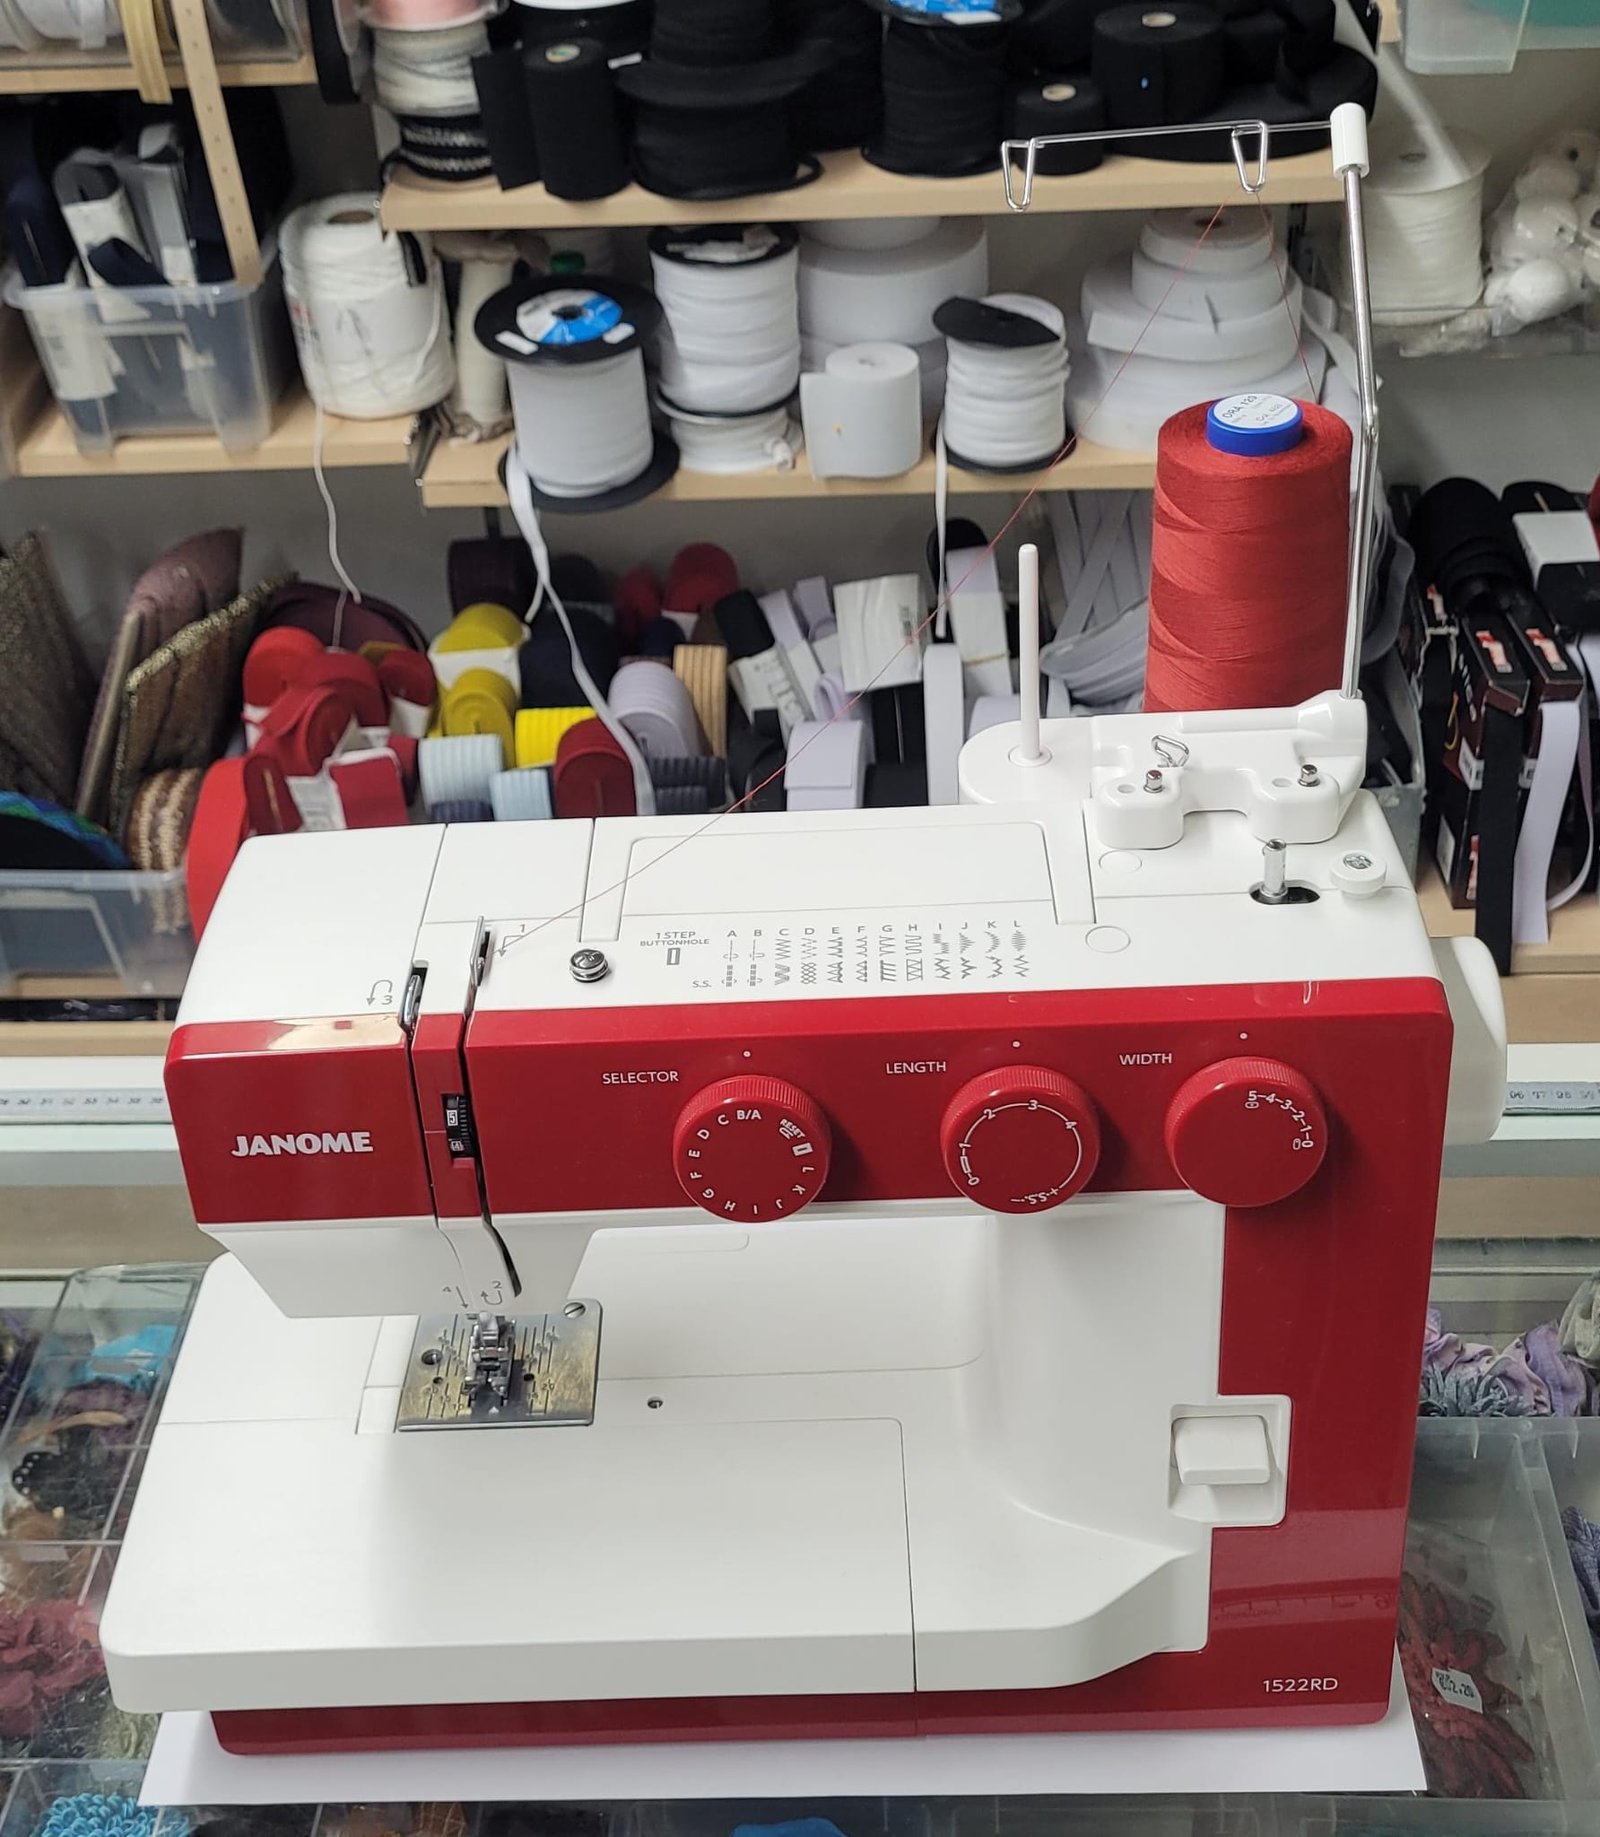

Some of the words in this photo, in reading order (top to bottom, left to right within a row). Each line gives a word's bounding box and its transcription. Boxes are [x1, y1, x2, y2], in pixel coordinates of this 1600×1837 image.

[779, 928, 790, 936] C
[804, 927, 815, 935] D
[832, 926, 840, 934] E
[857, 925, 865, 933] F
[882, 924, 893, 932] G
[908, 923, 918, 931] H
[961, 922, 968, 930] J
[987, 921, 997, 929] K
[1014, 920, 1021, 928] L
[661, 931, 697, 939] STEP
[640, 938, 710, 947] BUTTONHOLE
[692, 980, 712, 988] S.S.
[381, 995, 393, 1005] 3
[1119, 1053, 1173, 1065] WIDTH
[886, 1061, 947, 1074] LENGTH
[602, 1070, 679, 1084] SELECTOR
[717, 1114, 730, 1125] C
[736, 1109, 762, 1120] B/A
[780, 1118, 806, 1139] RESET
[696, 1129, 710, 1140] D
[231, 1131, 374, 1157] JANOME
[967, 1177, 980, 1186] 0
[983, 1108, 996, 1119] 2
[1027, 1099, 1038, 1110] 3
[1065, 1121, 1077, 1129] 4
[688, 1149, 700, 1158] E
[690, 1171, 702, 1179] F
[702, 1188, 715, 1198] G
[792, 1184, 806, 1195] K
[724, 1200, 736, 1211] H
[775, 1199, 784, 1209] J
[492, 1280, 503, 1289] 2
[1263, 1677, 1339, 1693] 1522RD
